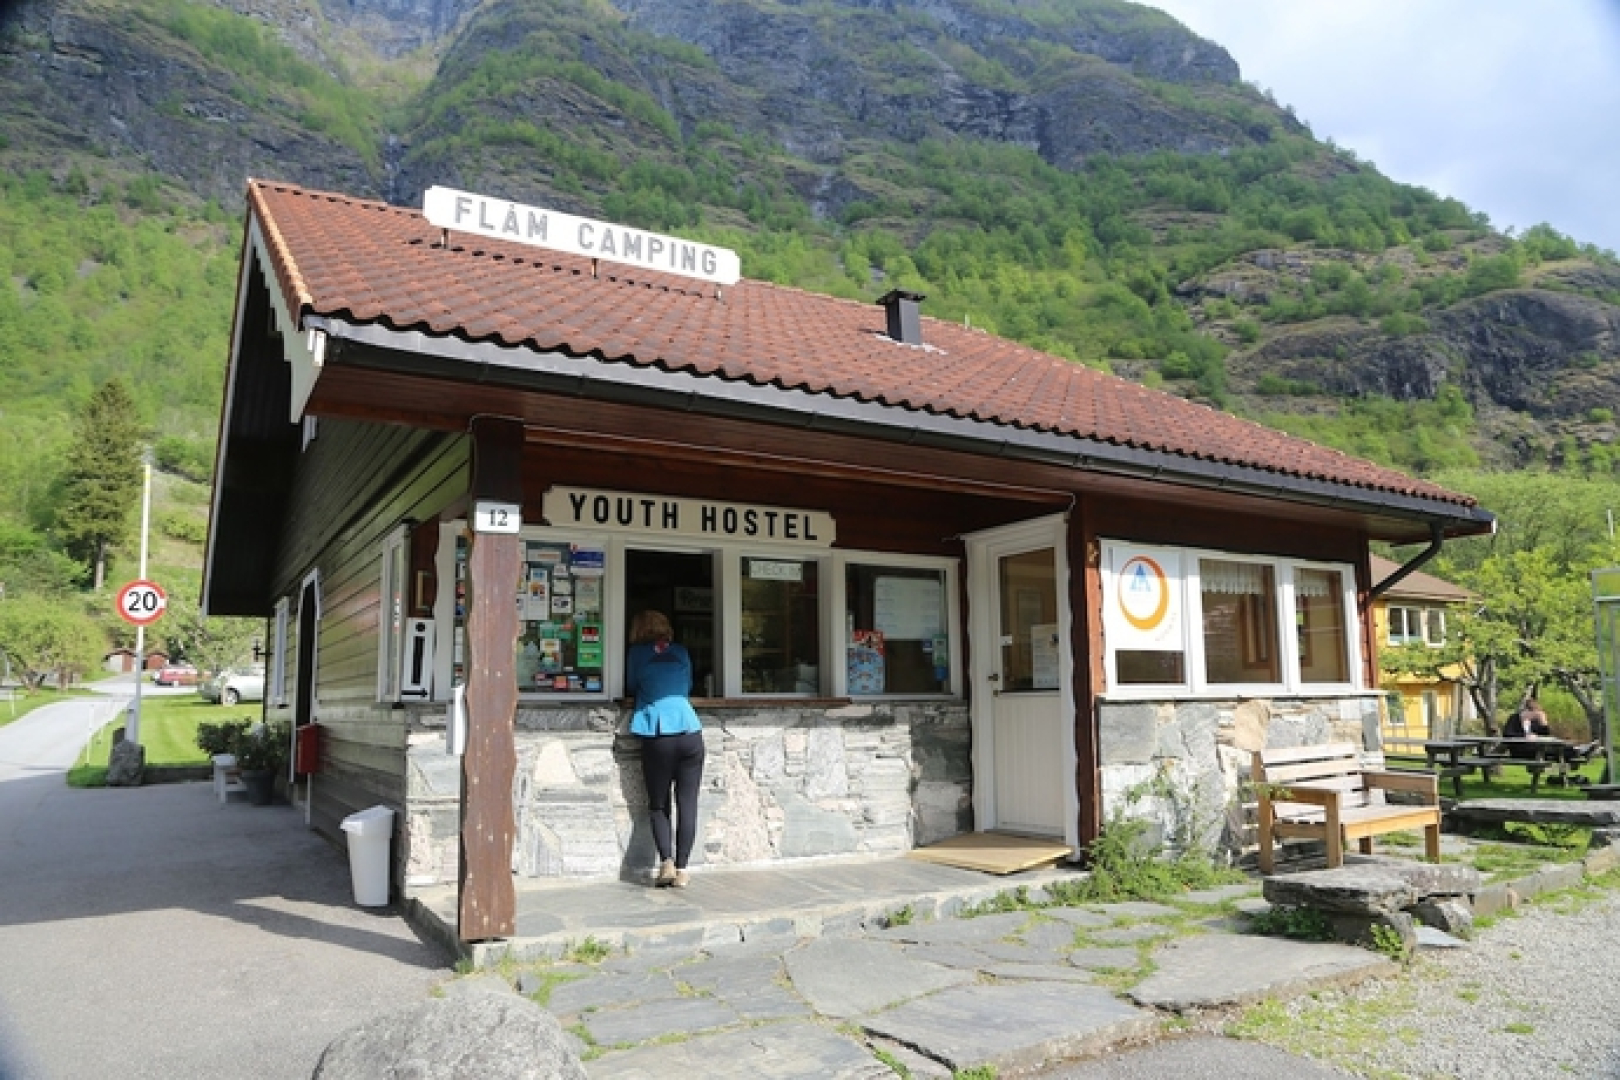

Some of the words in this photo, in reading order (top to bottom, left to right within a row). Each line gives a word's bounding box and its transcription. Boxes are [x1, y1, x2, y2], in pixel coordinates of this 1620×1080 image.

[453, 195, 549, 242] FLÅM
[577, 221, 718, 276] CAMPING
[488, 509, 509, 527] 12
[568, 492, 679, 530] YOUTH
[701, 504, 818, 541] HOSTEL
[128, 591, 158, 612] 20
